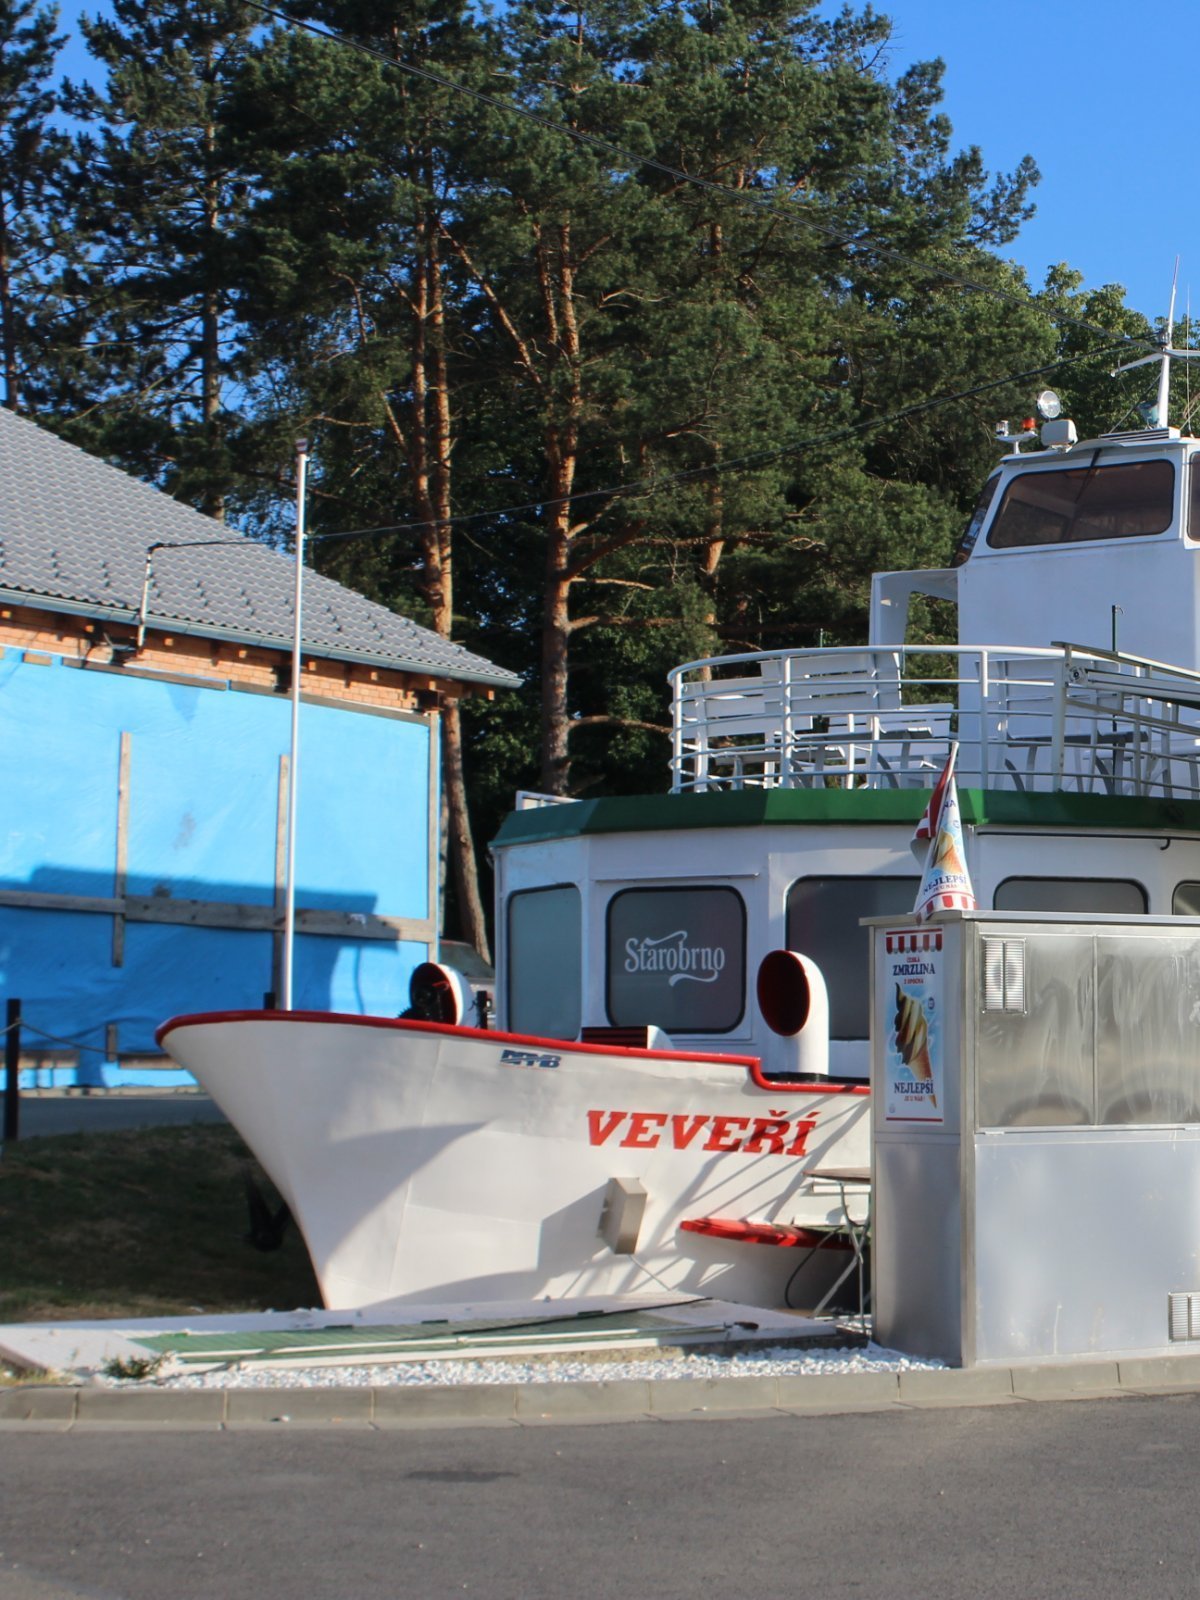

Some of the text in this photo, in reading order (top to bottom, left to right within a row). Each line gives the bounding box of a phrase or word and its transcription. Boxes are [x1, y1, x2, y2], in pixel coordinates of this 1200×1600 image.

[624, 930, 725, 987] Starobrno
[893, 963, 936, 976] ZMRZLINA
[894, 1079, 934, 1094] NEJLEPŠÍ
[586, 1109, 821, 1157] VEVEŘÍ
